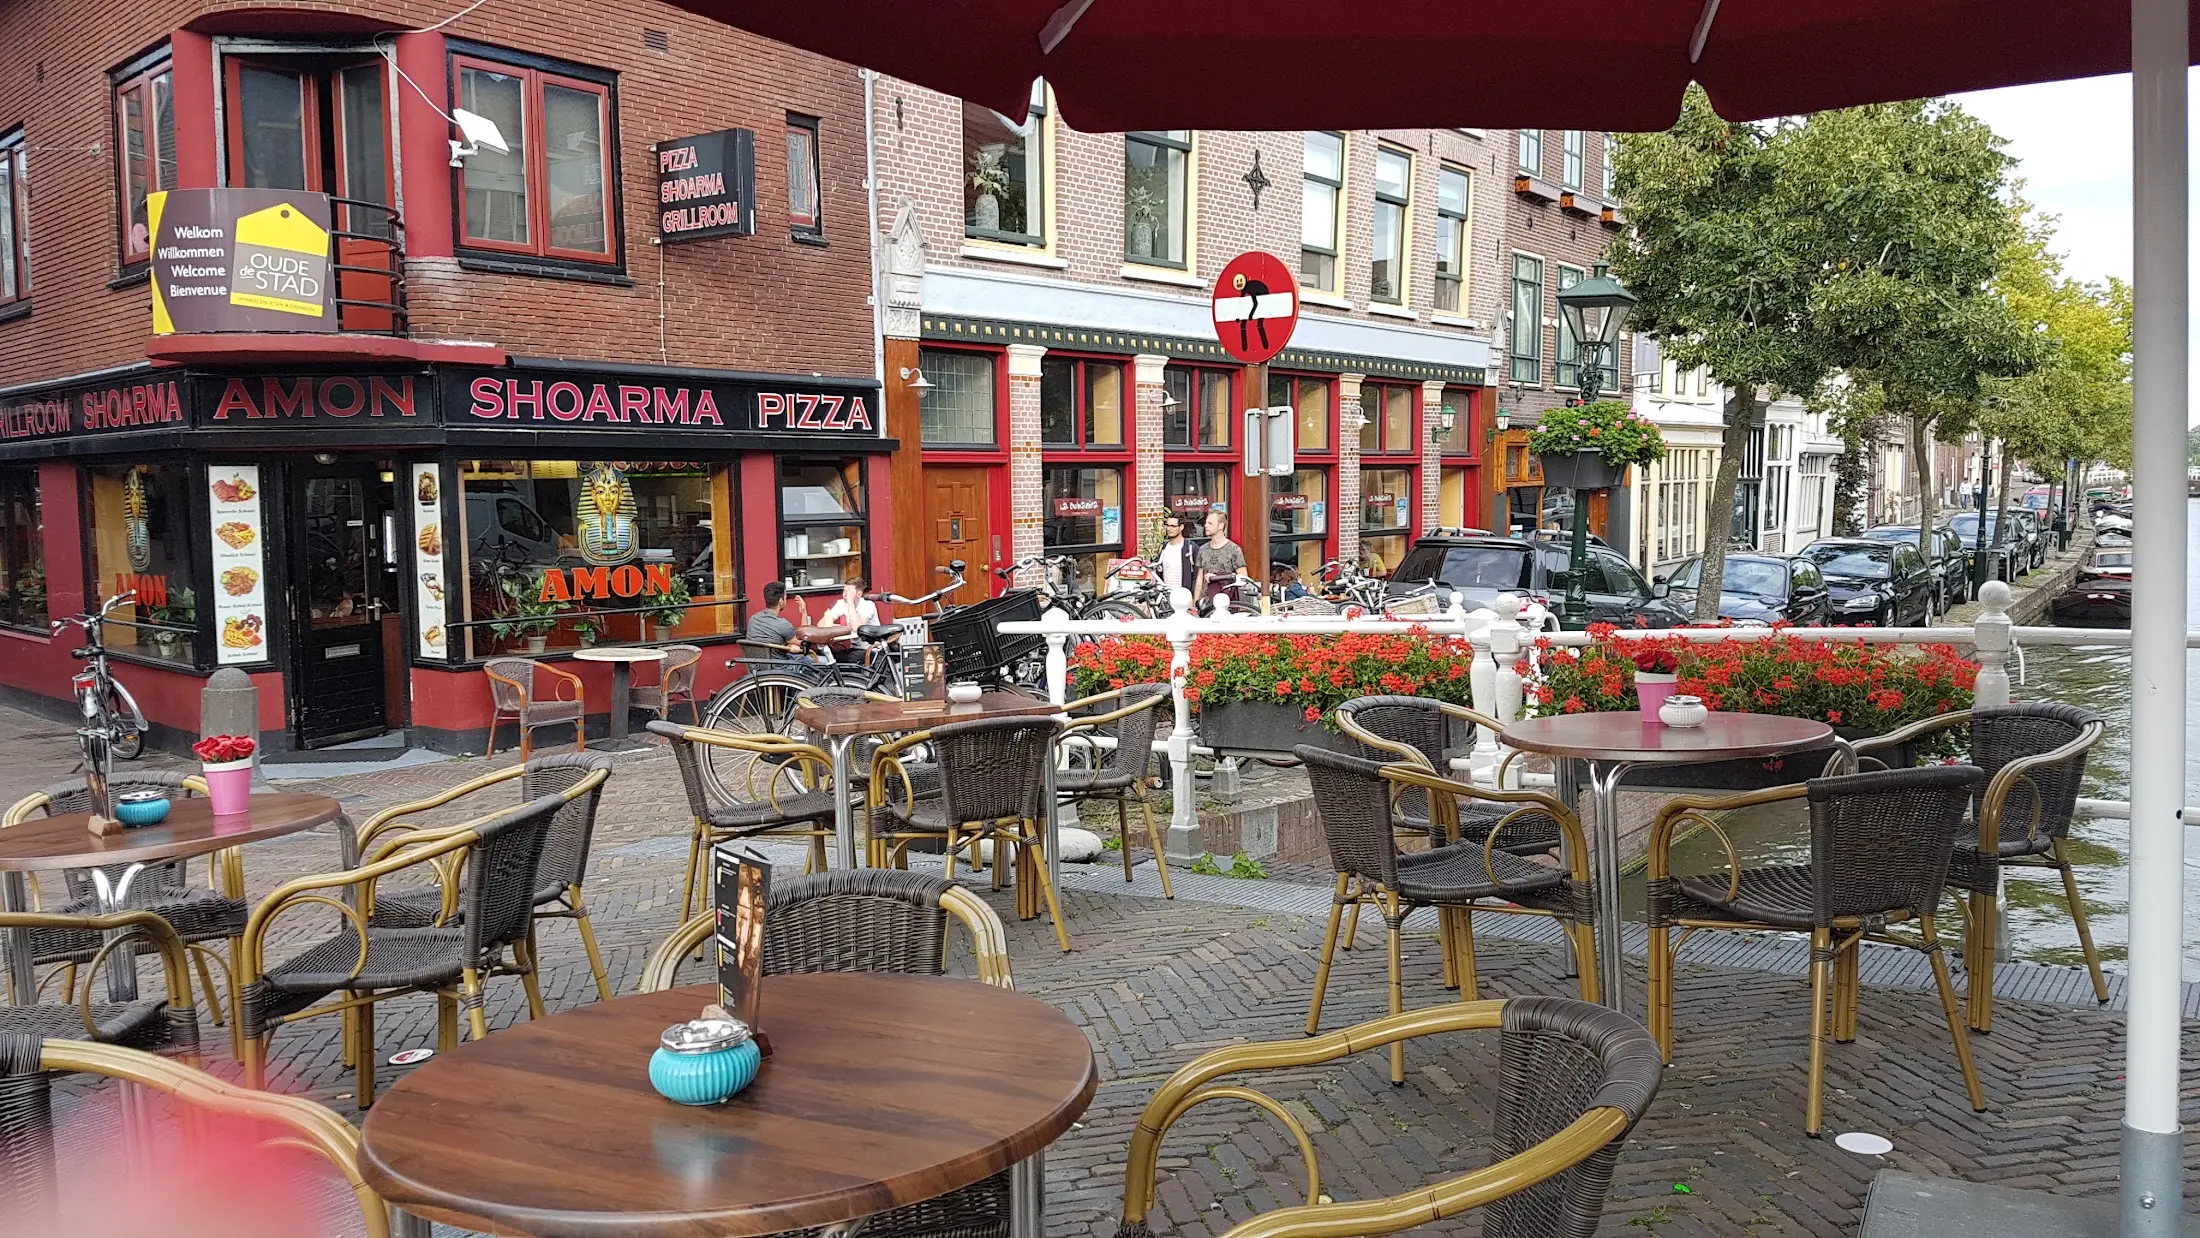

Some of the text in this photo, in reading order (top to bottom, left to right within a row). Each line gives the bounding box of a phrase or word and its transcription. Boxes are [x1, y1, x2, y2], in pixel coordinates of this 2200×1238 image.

[660, 146, 698, 173] PIZZA
[661, 172, 726, 203] SHOARMA
[662, 201, 739, 233] GRILLROOM
[174, 225, 224, 239] Welkom
[158, 246, 225, 260] Willkommen
[250, 253, 310, 277] OUDE
[171, 264, 226, 278] Welcome
[239, 264, 255, 278] de
[255, 270, 319, 297] STAD
[170, 284, 227, 298] Bienvenue
[83, 381, 183, 429] SHOARMA
[213, 376, 417, 419] AMON
[470, 377, 873, 431] SHOARMA PIZZA
[116, 573, 168, 607] AMON
[538, 564, 672, 602] AMON
